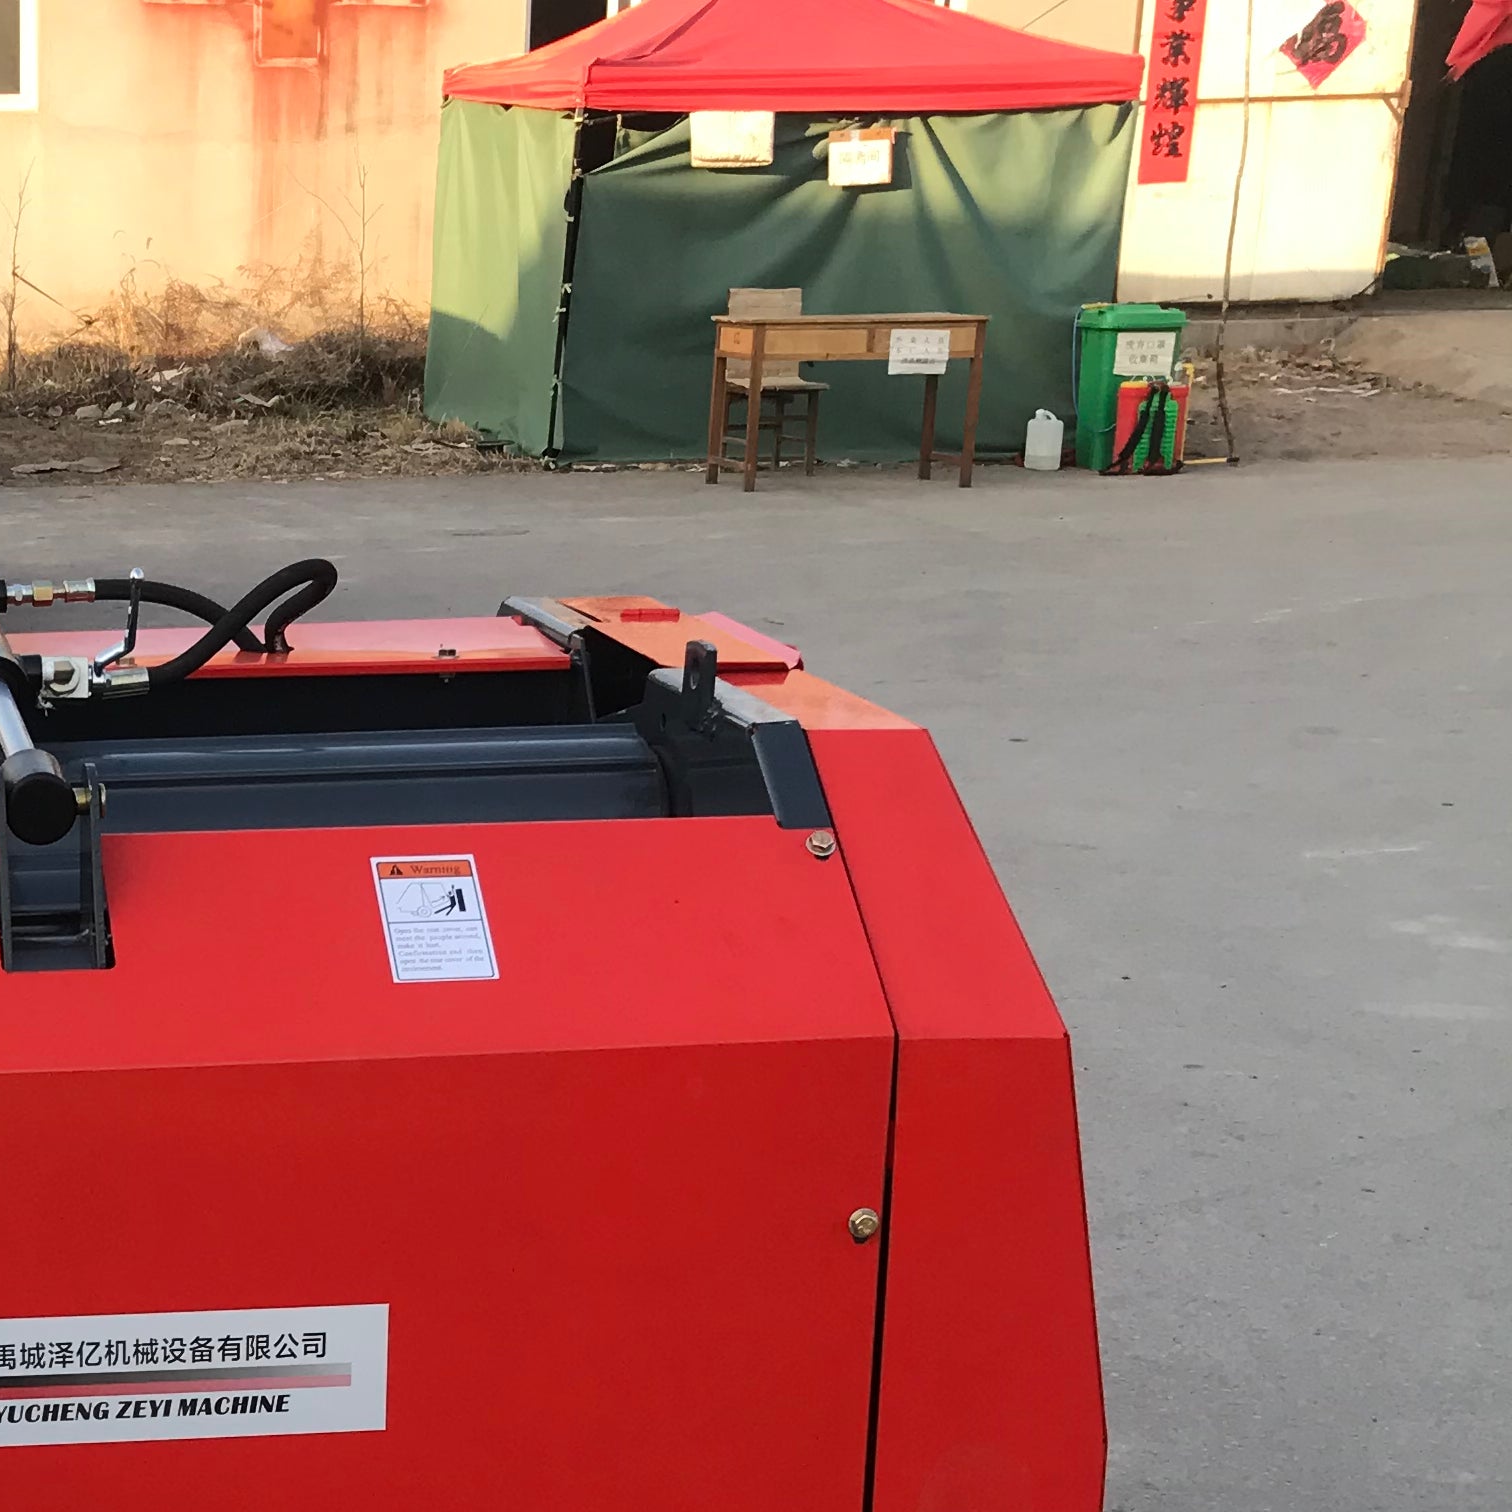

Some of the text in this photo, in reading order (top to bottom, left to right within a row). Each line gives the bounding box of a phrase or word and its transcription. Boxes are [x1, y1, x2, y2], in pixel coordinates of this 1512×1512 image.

[410, 864, 461, 876] Warning
[115, 1398, 172, 1419] ZEYI
[177, 1394, 291, 1417] MACHINE
